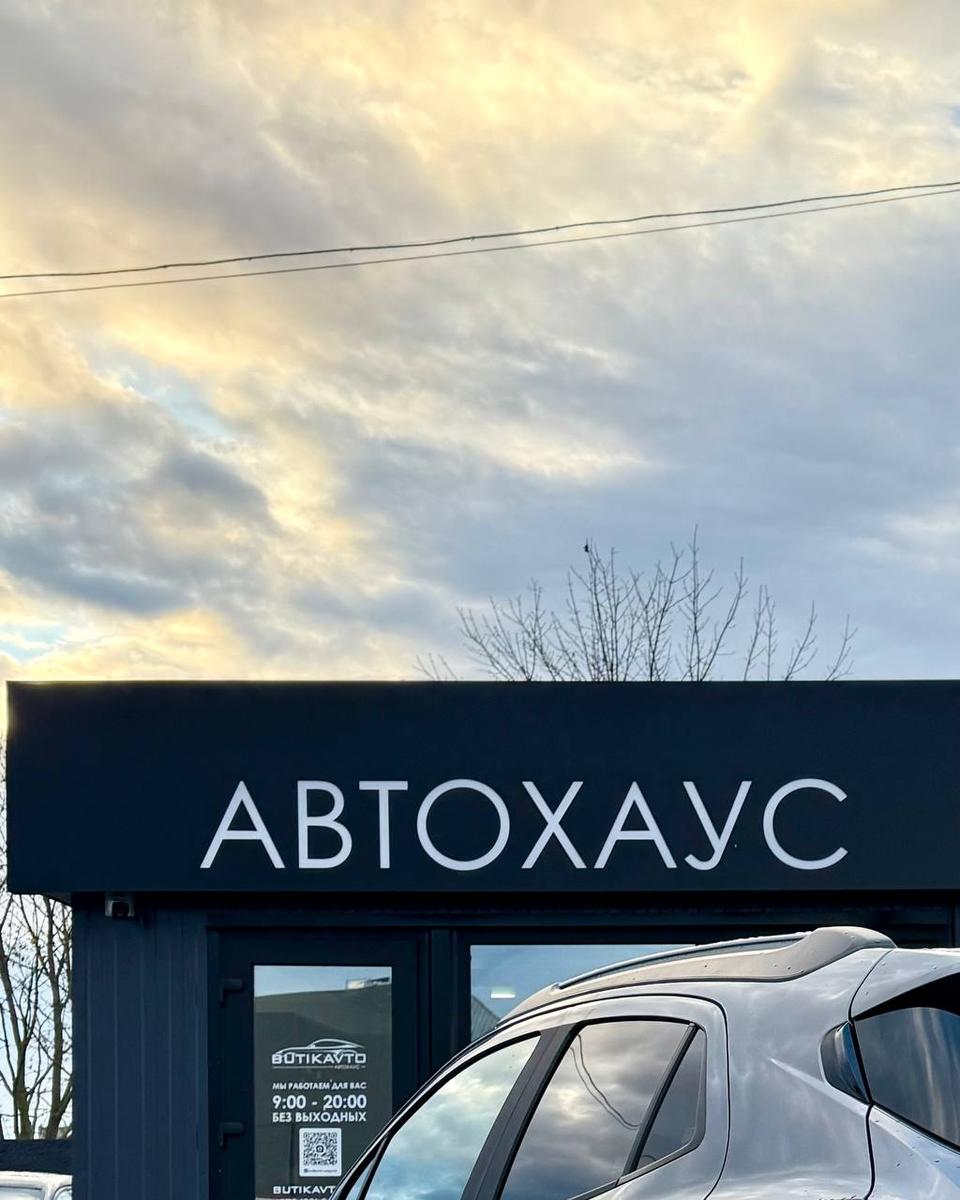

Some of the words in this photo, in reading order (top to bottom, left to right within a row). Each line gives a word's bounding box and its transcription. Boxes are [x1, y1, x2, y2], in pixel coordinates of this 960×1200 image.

[200, 778, 849, 872] АВТОХАУС
[271, 1053, 367, 1065] BUTIKAVTO
[272, 1082, 287, 1090] МЫ
[288, 1082, 330, 1090] РАБОТАЕМ
[331, 1082, 348, 1090] ДЛЯ
[350, 1082, 367, 1090] ВАС
[272, 1094, 306, 1109] 9:00
[323, 1094, 367, 1109] 20:00
[272, 1111, 292, 1123] БЕЗ
[295, 1111, 367, 1123] ВЫХОДНЫХ
[273, 1185, 337, 1195] BUTIKAVT
